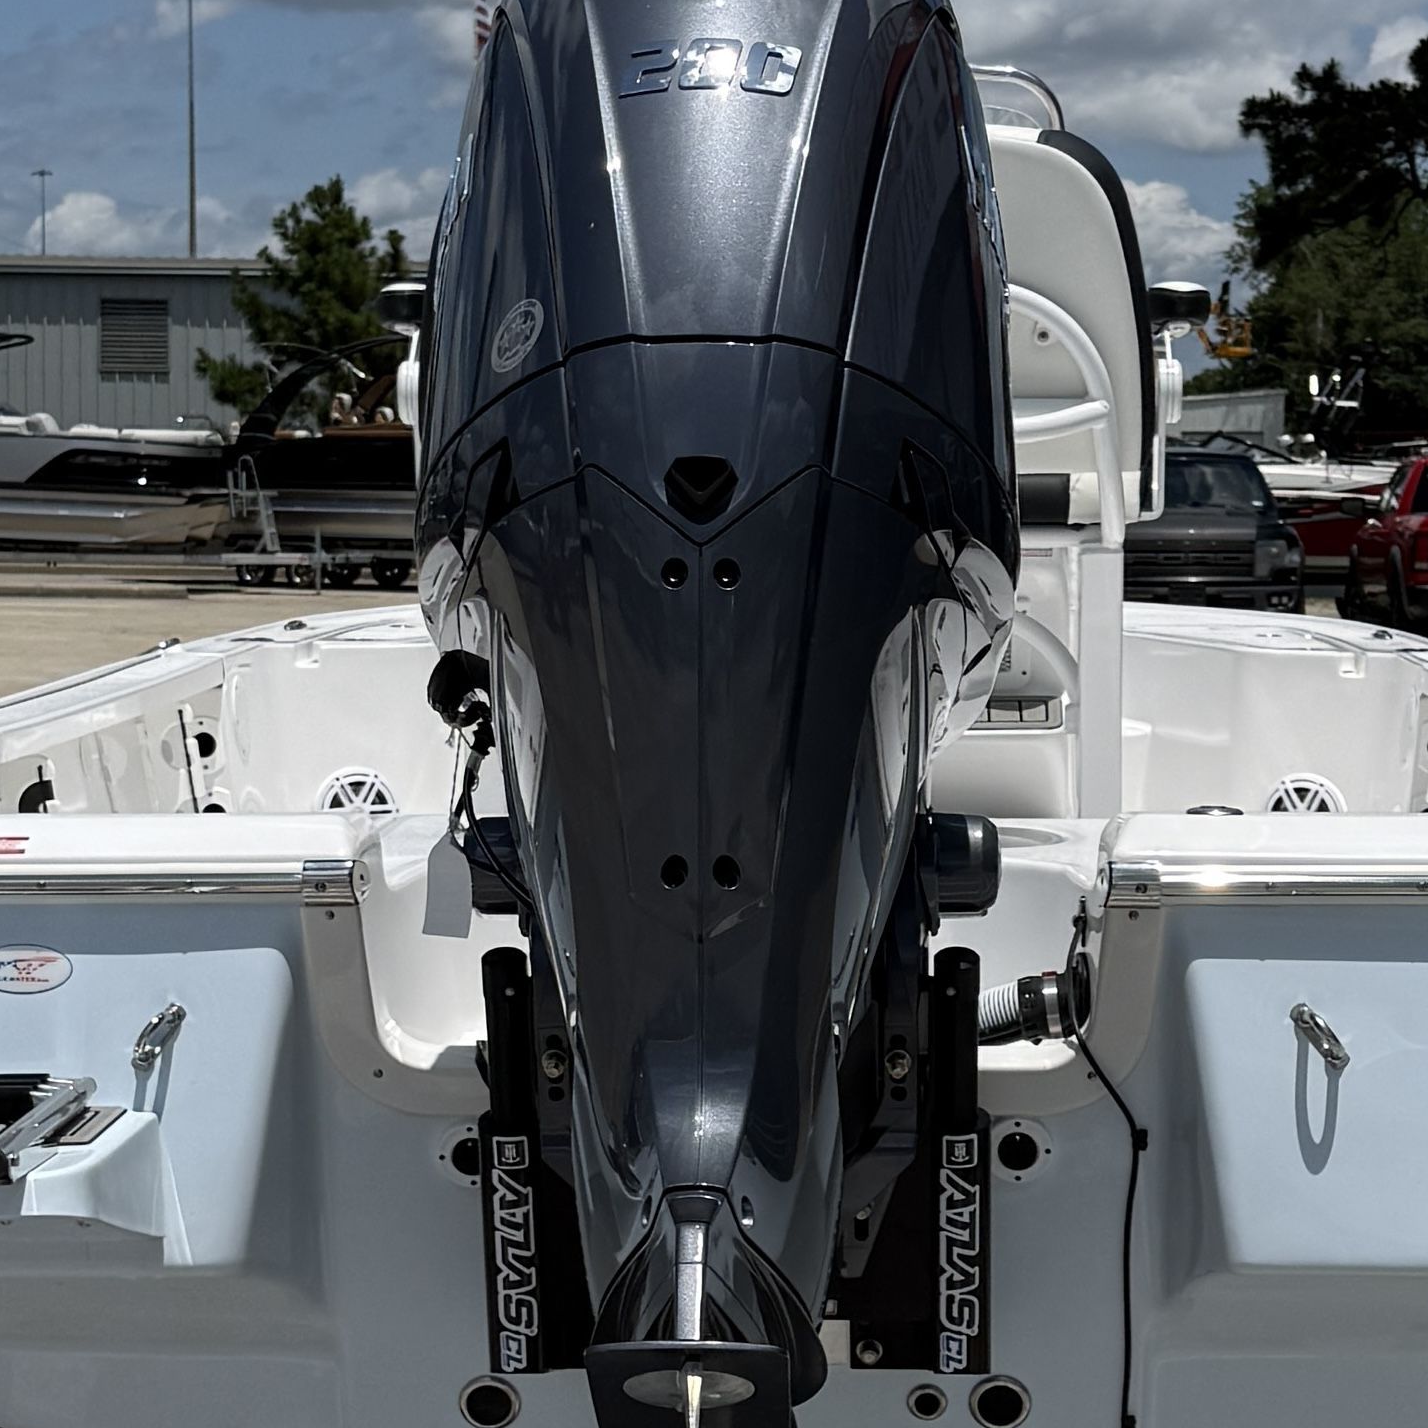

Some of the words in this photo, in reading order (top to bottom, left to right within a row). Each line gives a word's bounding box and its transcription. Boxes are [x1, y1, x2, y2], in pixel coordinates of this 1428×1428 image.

[618, 37, 804, 100] 200
[492, 1168, 538, 1337] ATLAS
[939, 1168, 980, 1336] ATLAS
